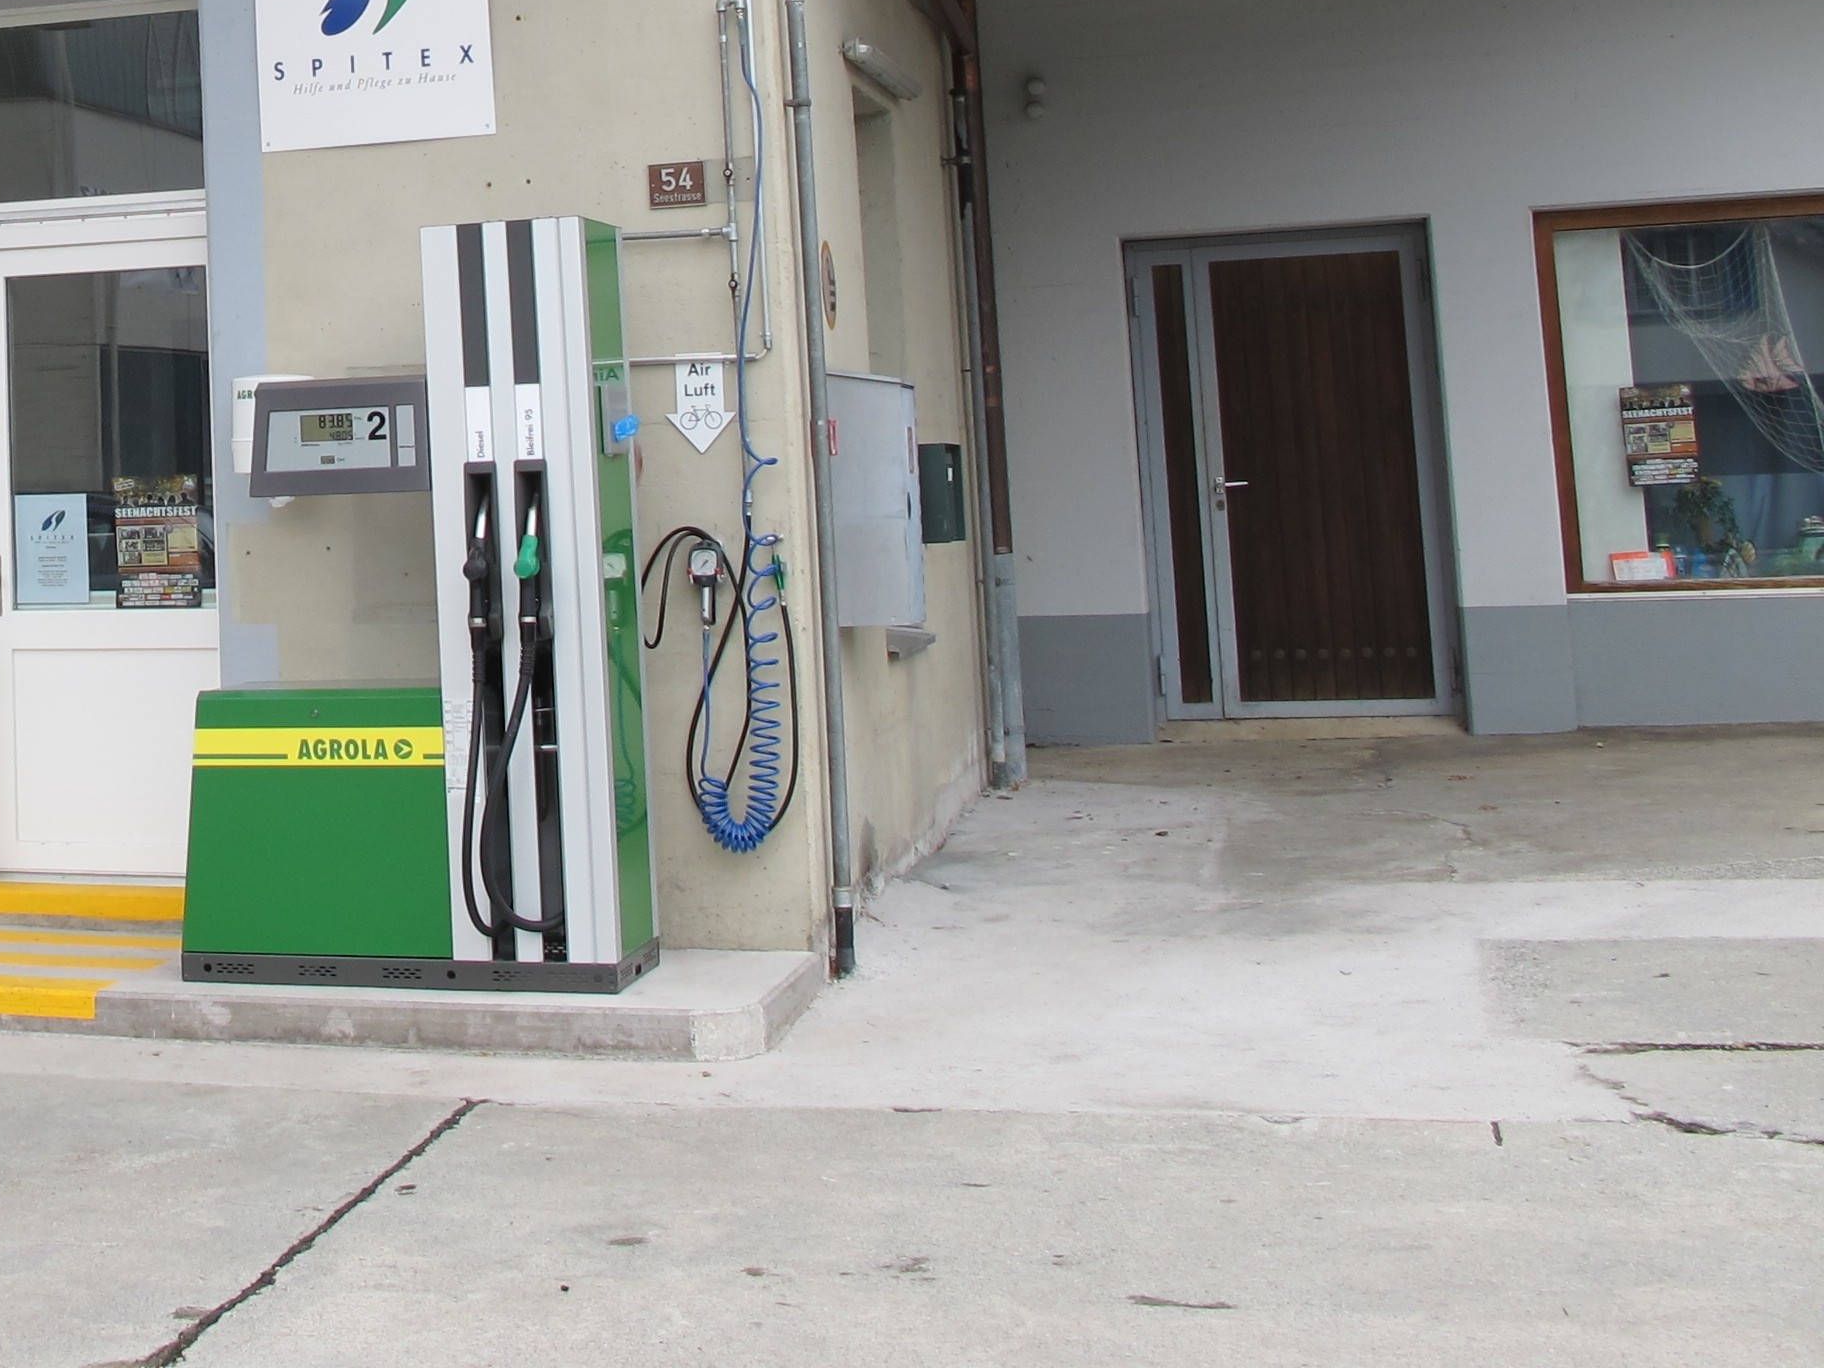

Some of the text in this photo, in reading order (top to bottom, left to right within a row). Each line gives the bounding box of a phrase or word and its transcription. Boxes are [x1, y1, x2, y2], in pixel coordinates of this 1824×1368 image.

[273, 44, 474, 81] SPITEX
[293, 72, 457, 96] Hilfe und Pflege zu Hause
[660, 166, 694, 191] 54
[687, 363, 711, 376] Air
[684, 383, 716, 397] Luft
[367, 411, 387, 440] 2
[524, 408, 535, 456] Bleifrei 95
[475, 431, 485, 458] Diesel
[114, 505, 197, 518] SEENACHTSFEST
[297, 738, 389, 760] AGROLA
